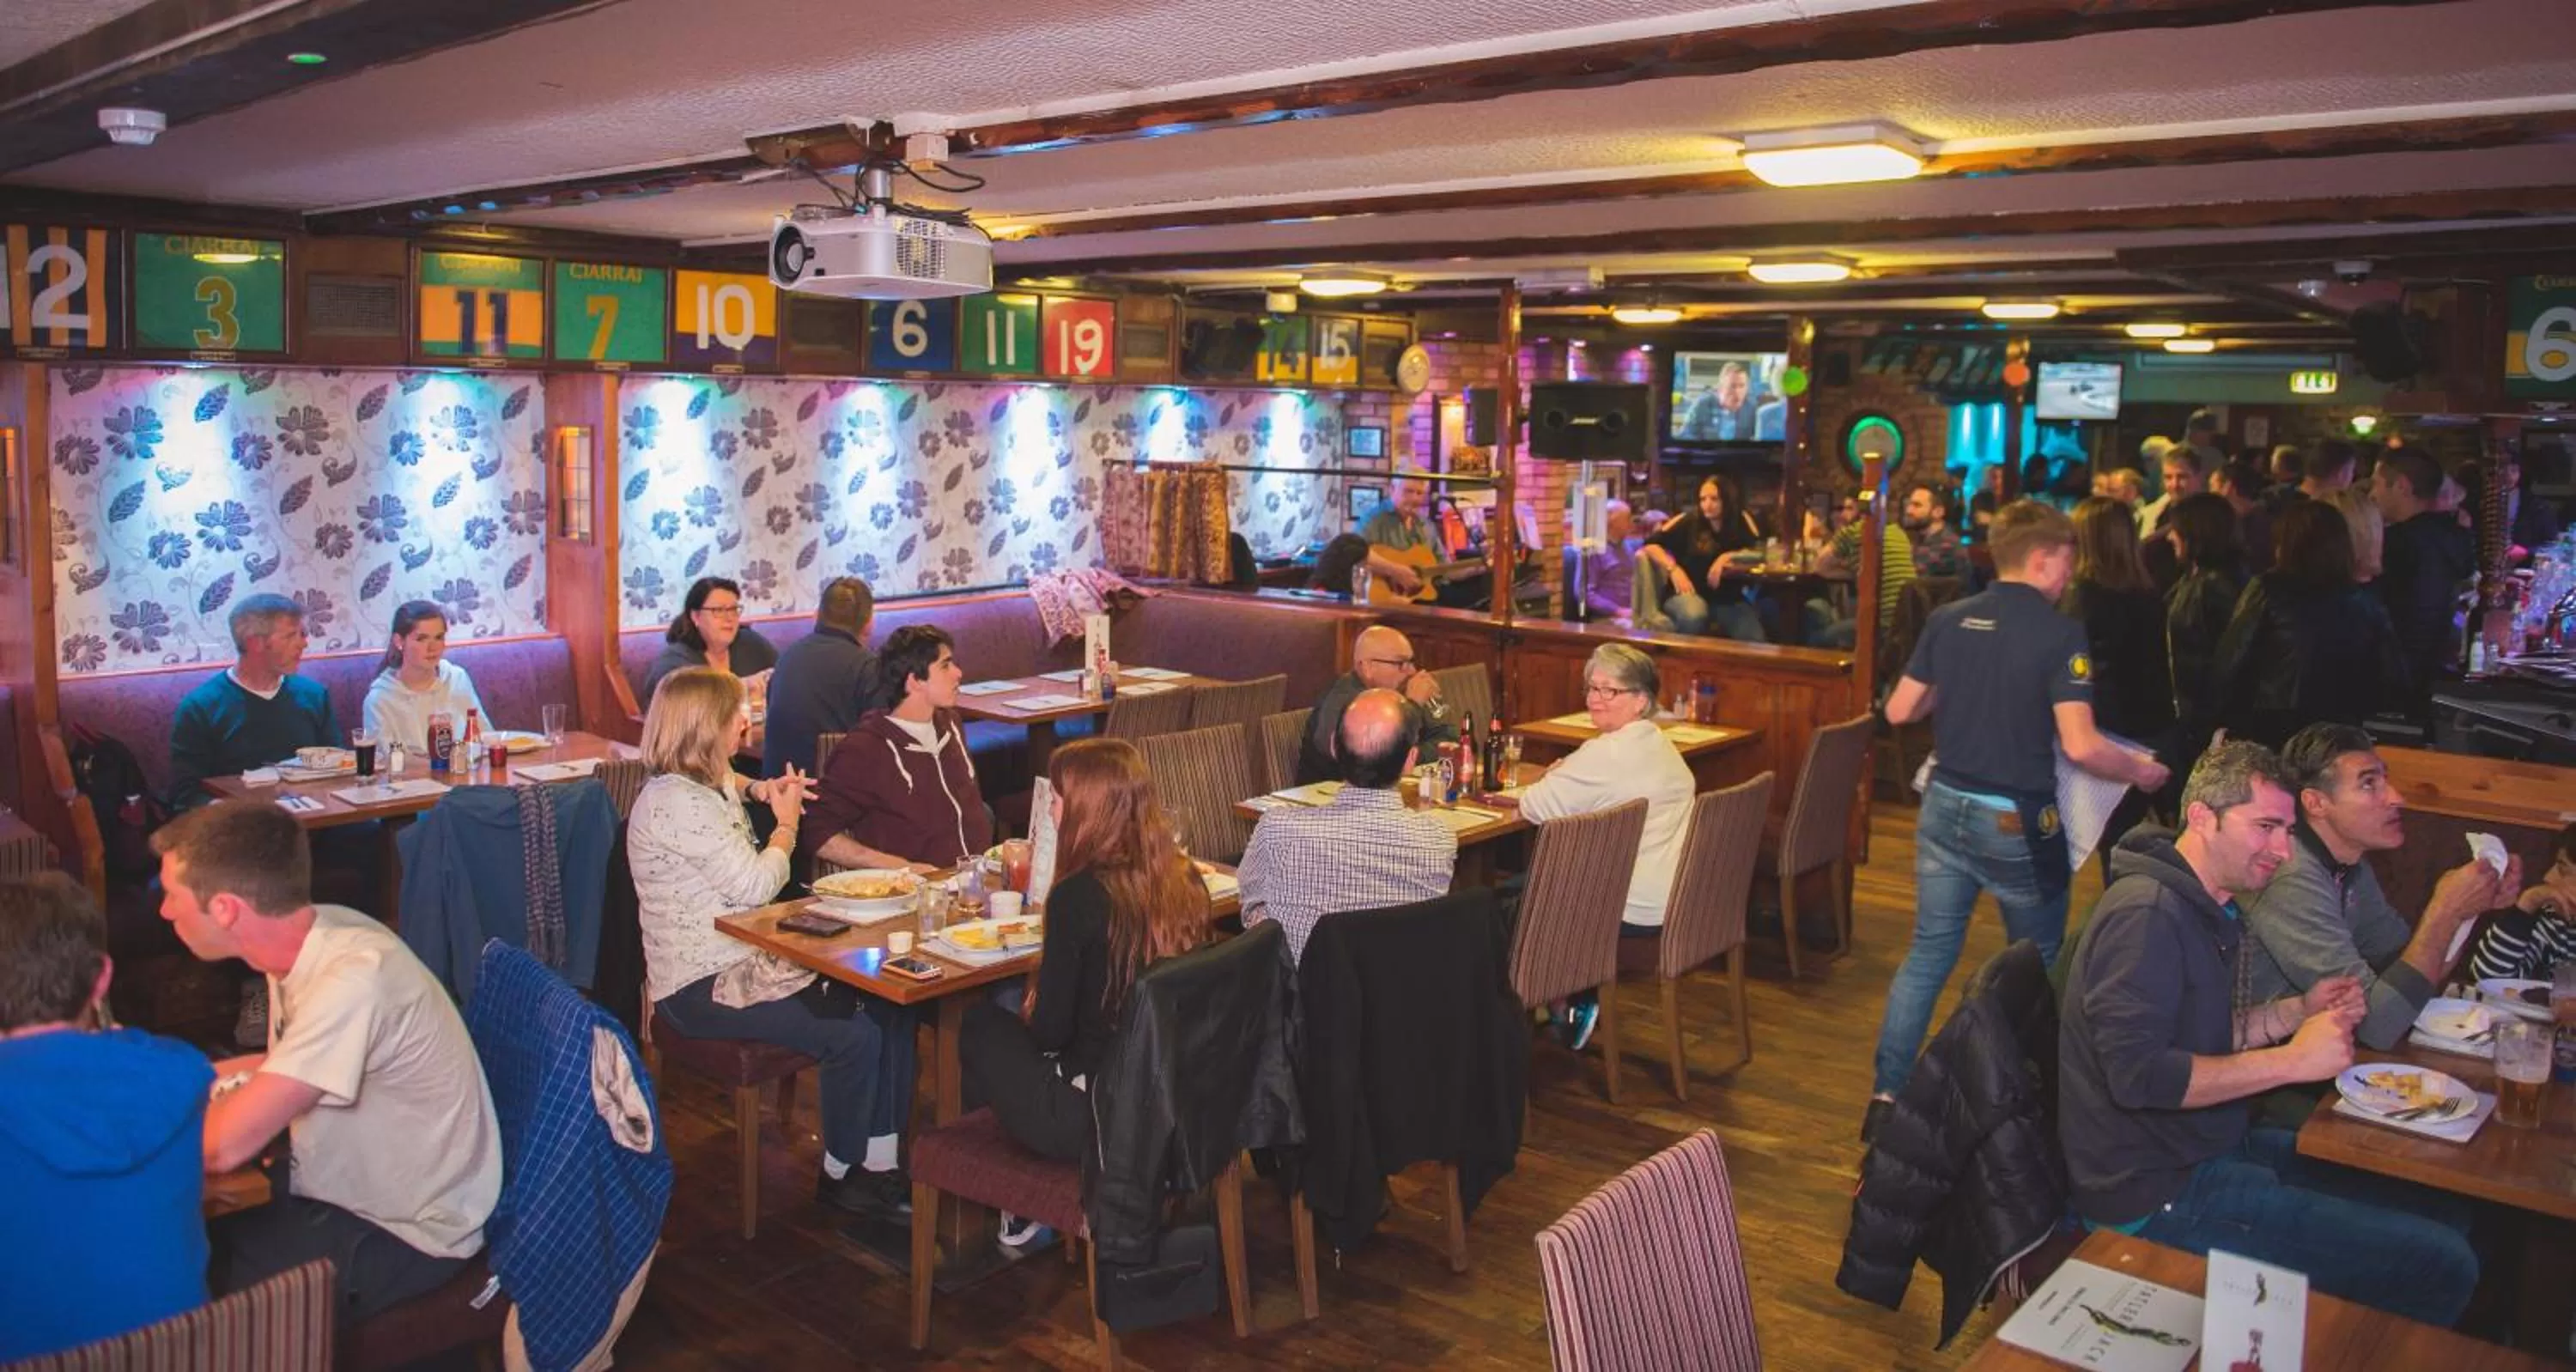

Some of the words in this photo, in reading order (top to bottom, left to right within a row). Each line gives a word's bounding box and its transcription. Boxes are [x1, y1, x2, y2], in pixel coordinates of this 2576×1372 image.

[193, 276, 240, 349] 3
[455, 290, 507, 354] 11
[586, 295, 619, 361] 7
[696, 284, 756, 350] 10
[892, 300, 928, 358] 6
[986, 310, 1016, 366] 11
[2526, 307, 2576, 382] 6
[1060, 318, 1104, 375] 19
[1321, 321, 1351, 370] 15
